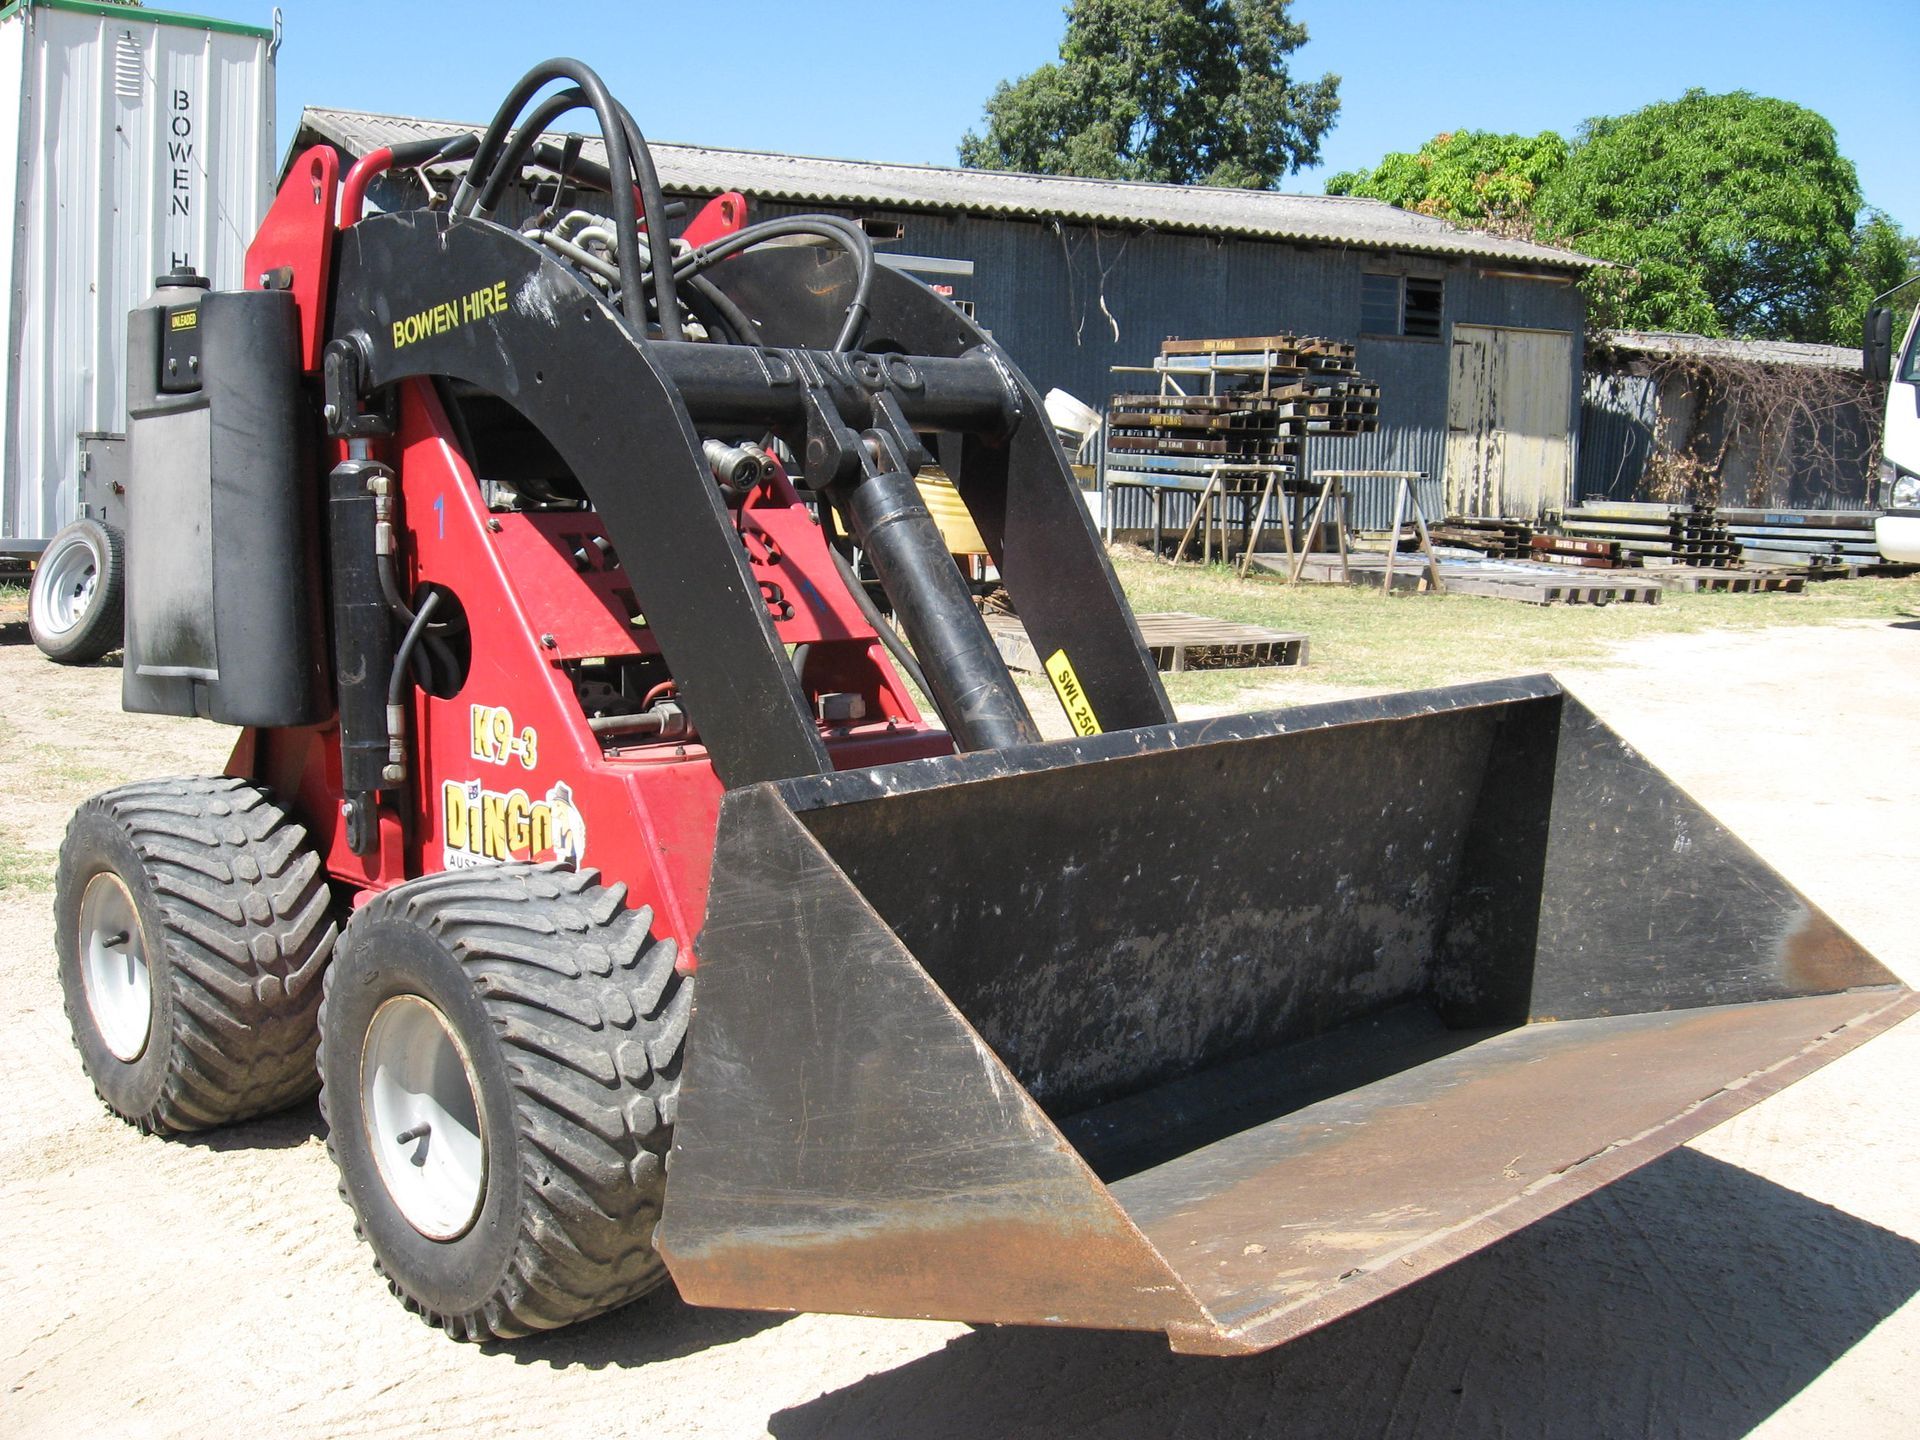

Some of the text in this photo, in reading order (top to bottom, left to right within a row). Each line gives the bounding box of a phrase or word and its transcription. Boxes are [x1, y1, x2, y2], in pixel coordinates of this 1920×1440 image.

[168, 89, 193, 217] BOWEN
[392, 280, 509, 349] BOWEN HIRE
[749, 347, 926, 395] DINGO
[1058, 670, 1096, 736] SWL 250
[472, 705, 537, 768] K9-3
